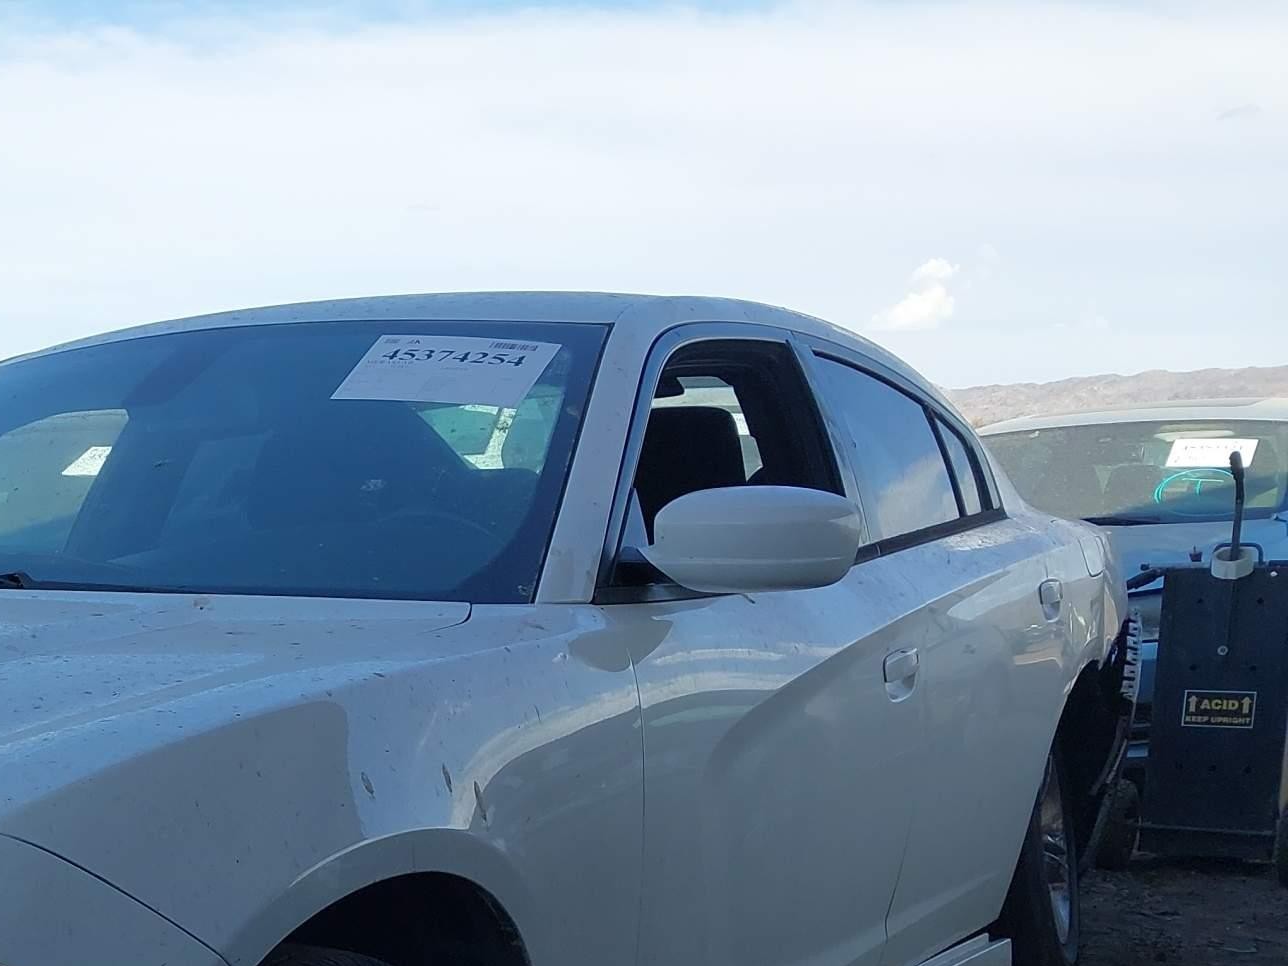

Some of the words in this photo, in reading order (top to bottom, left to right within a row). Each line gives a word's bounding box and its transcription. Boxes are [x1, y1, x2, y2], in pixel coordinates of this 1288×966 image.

[382, 348, 527, 367] 45374254
[1199, 698, 1240, 711] ACID
[1185, 715, 1209, 723] KEEP
[1210, 716, 1251, 724] UPRIGHT
